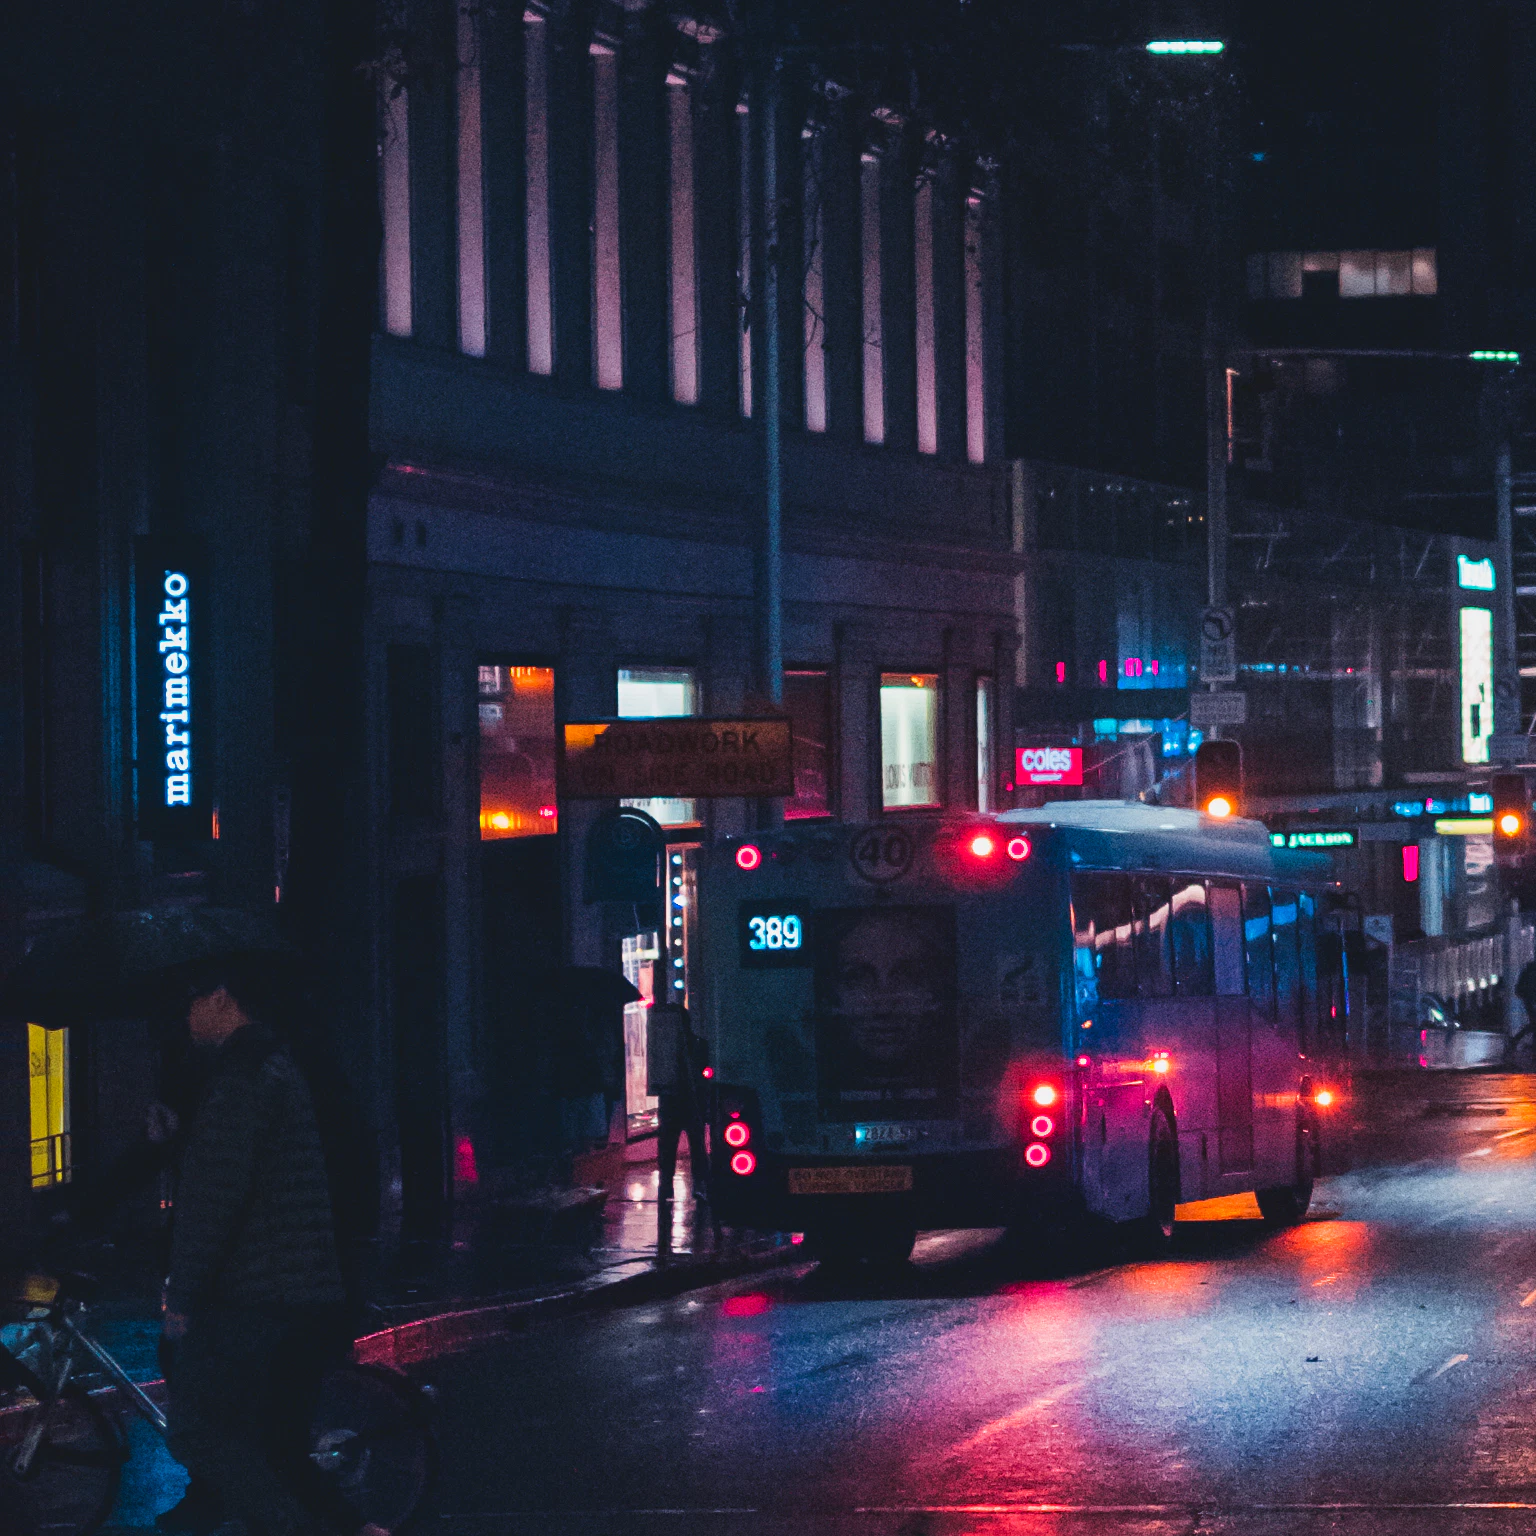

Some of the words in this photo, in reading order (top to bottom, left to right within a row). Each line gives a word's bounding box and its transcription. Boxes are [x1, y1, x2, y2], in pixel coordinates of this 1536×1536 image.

[158, 572, 191, 807] marimekko
[597, 730, 760, 754] ROADWORK
[1022, 746, 1072, 772] coles
[858, 836, 907, 868] 40
[749, 915, 802, 950] 389
